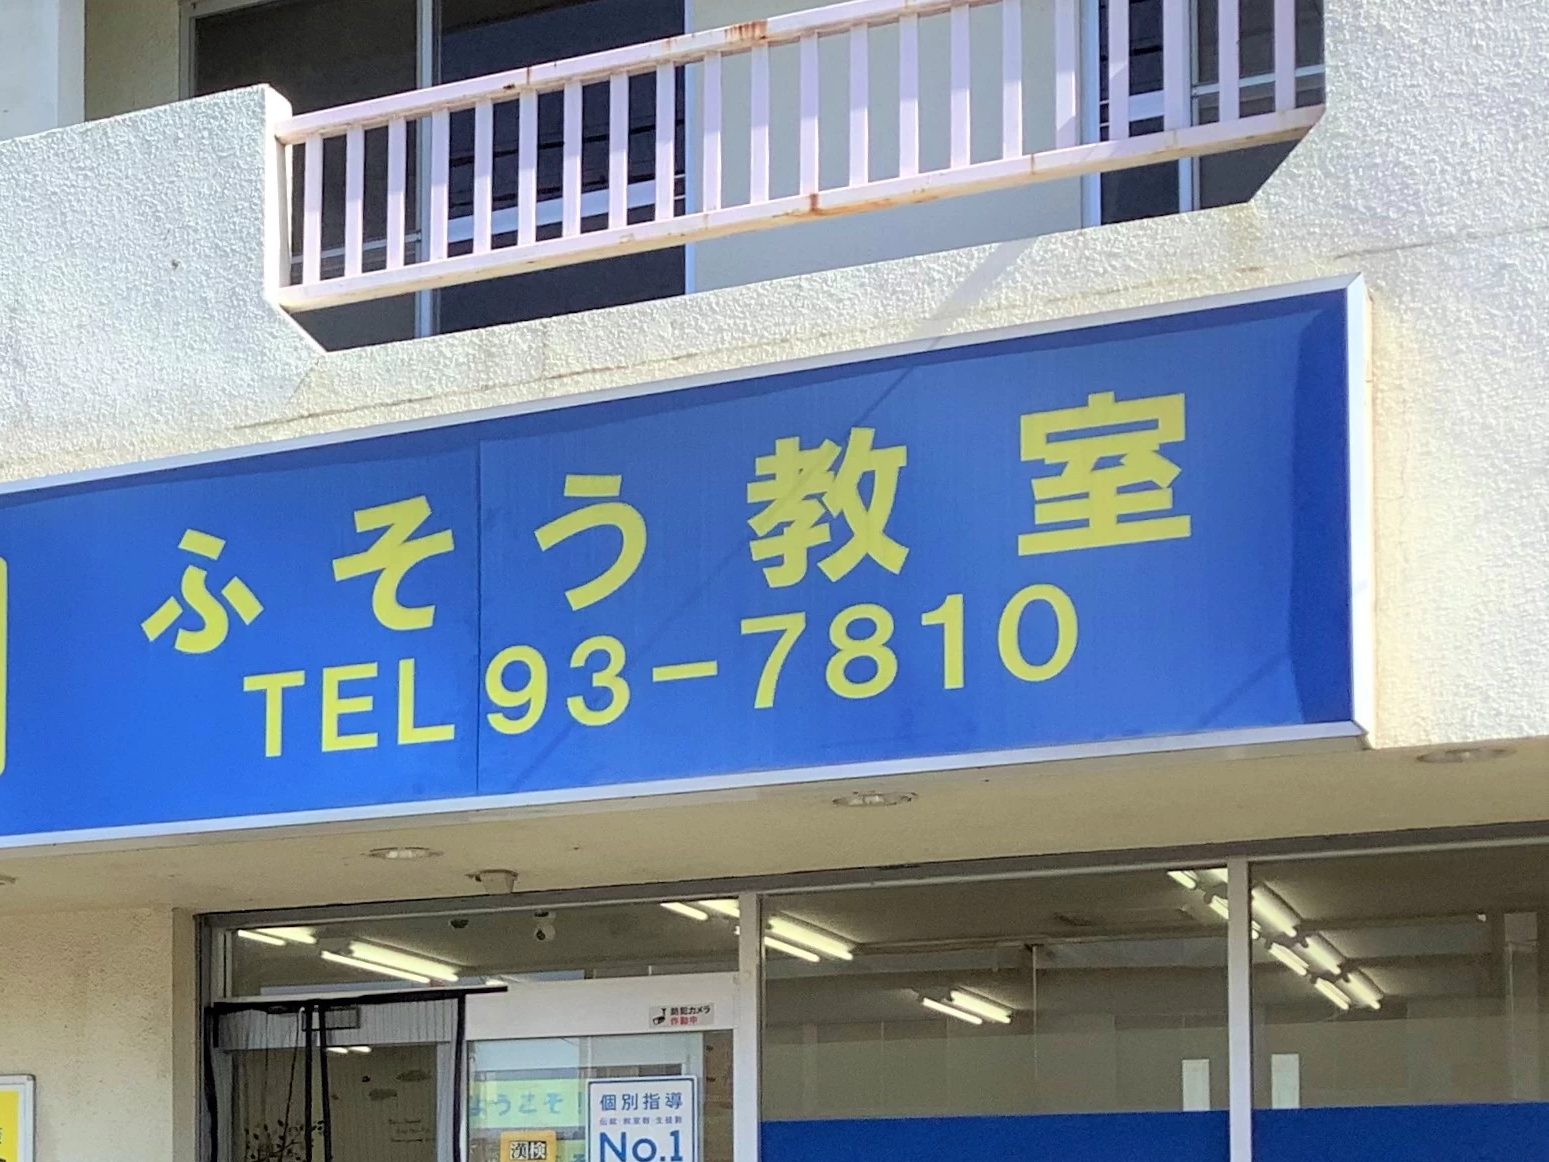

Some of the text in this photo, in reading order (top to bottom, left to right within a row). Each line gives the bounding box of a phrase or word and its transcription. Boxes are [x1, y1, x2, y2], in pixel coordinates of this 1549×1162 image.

[142, 390, 1192, 655] ふそう教室
[600, 1091, 684, 1112] 個別指導
[510, 1141, 547, 1161] 漢検
